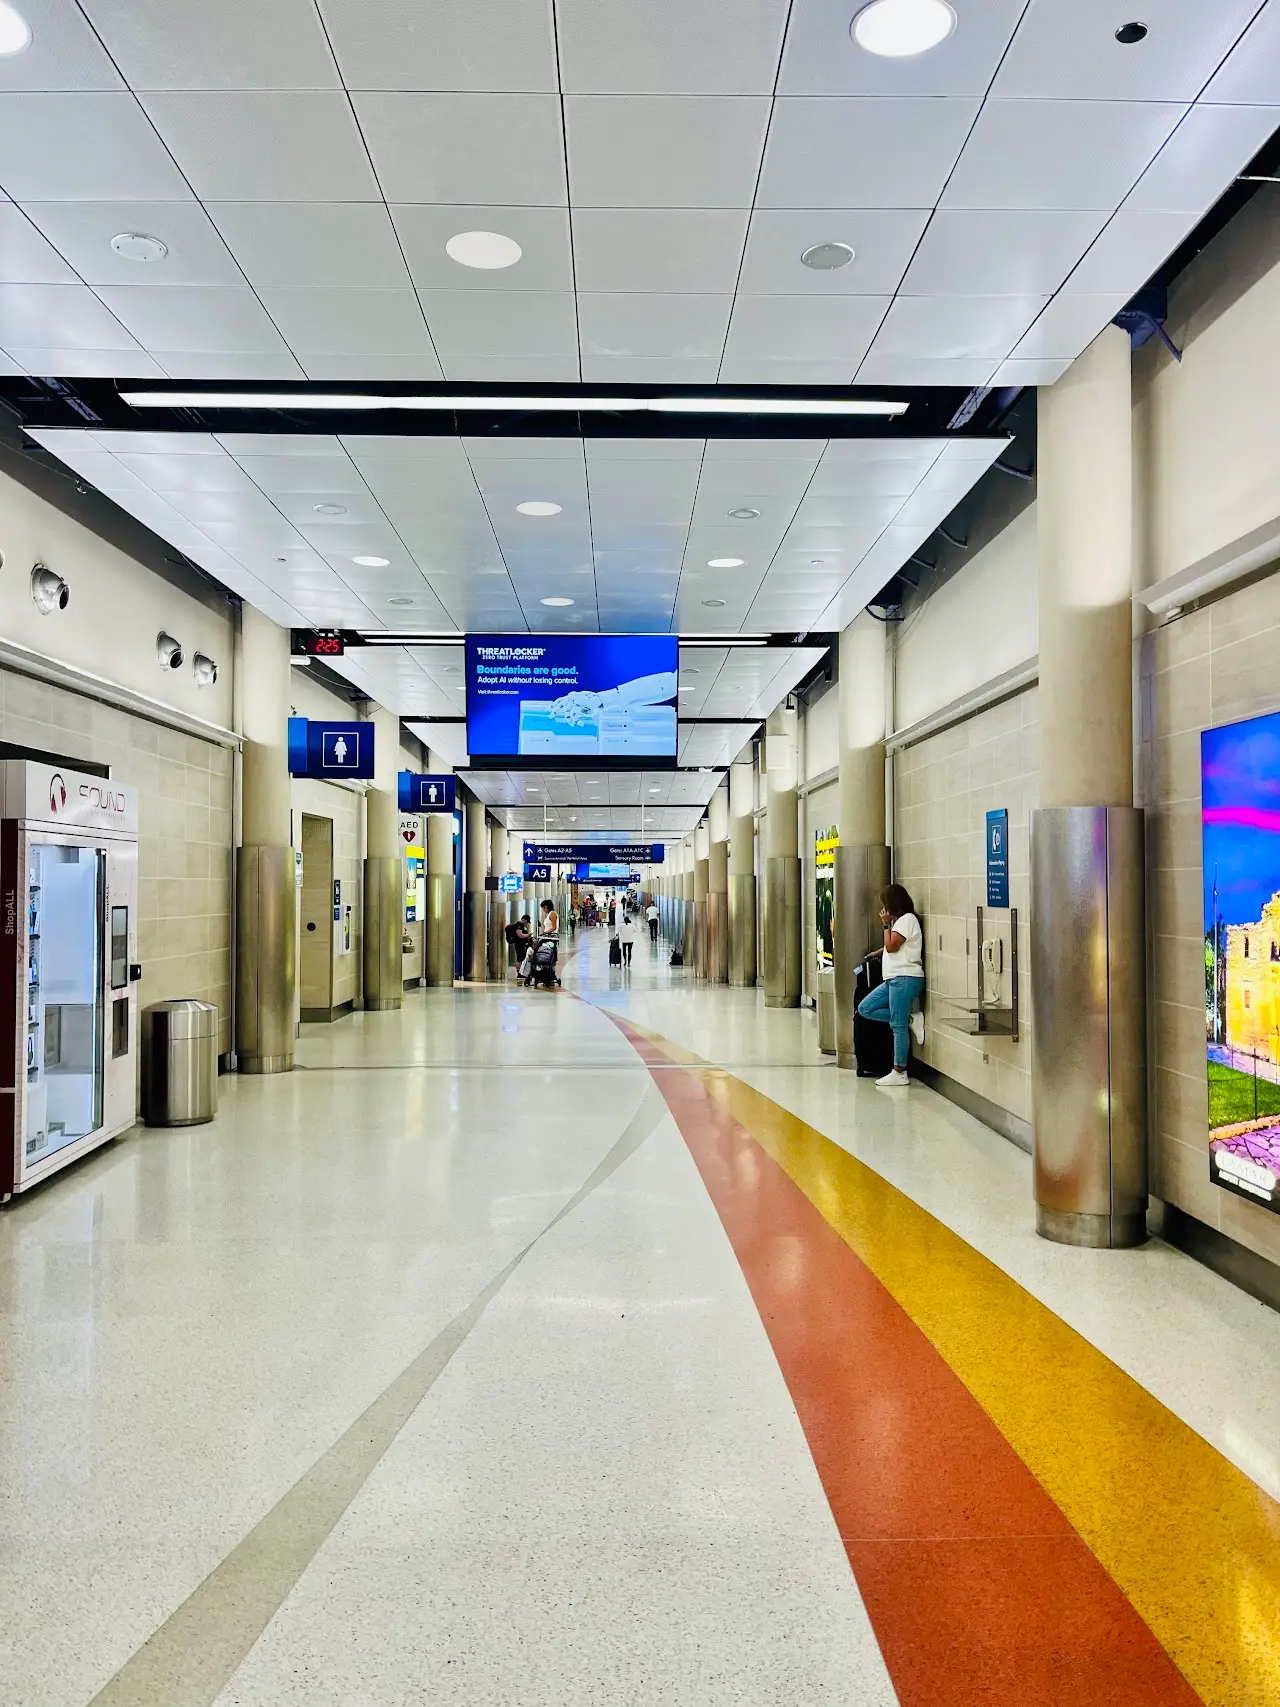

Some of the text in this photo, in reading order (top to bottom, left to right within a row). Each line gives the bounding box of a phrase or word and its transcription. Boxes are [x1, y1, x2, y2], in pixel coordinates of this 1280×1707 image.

[316, 639, 339, 652] 2:25
[477, 665, 530, 674] Boundaries
[551, 666, 578, 676] good.
[477, 676, 498, 684] Adopt
[533, 677, 552, 685] losing
[79, 785, 125, 812] SOUND
[533, 869, 547, 878] A5
[5, 889, 15, 935] ShopALL
